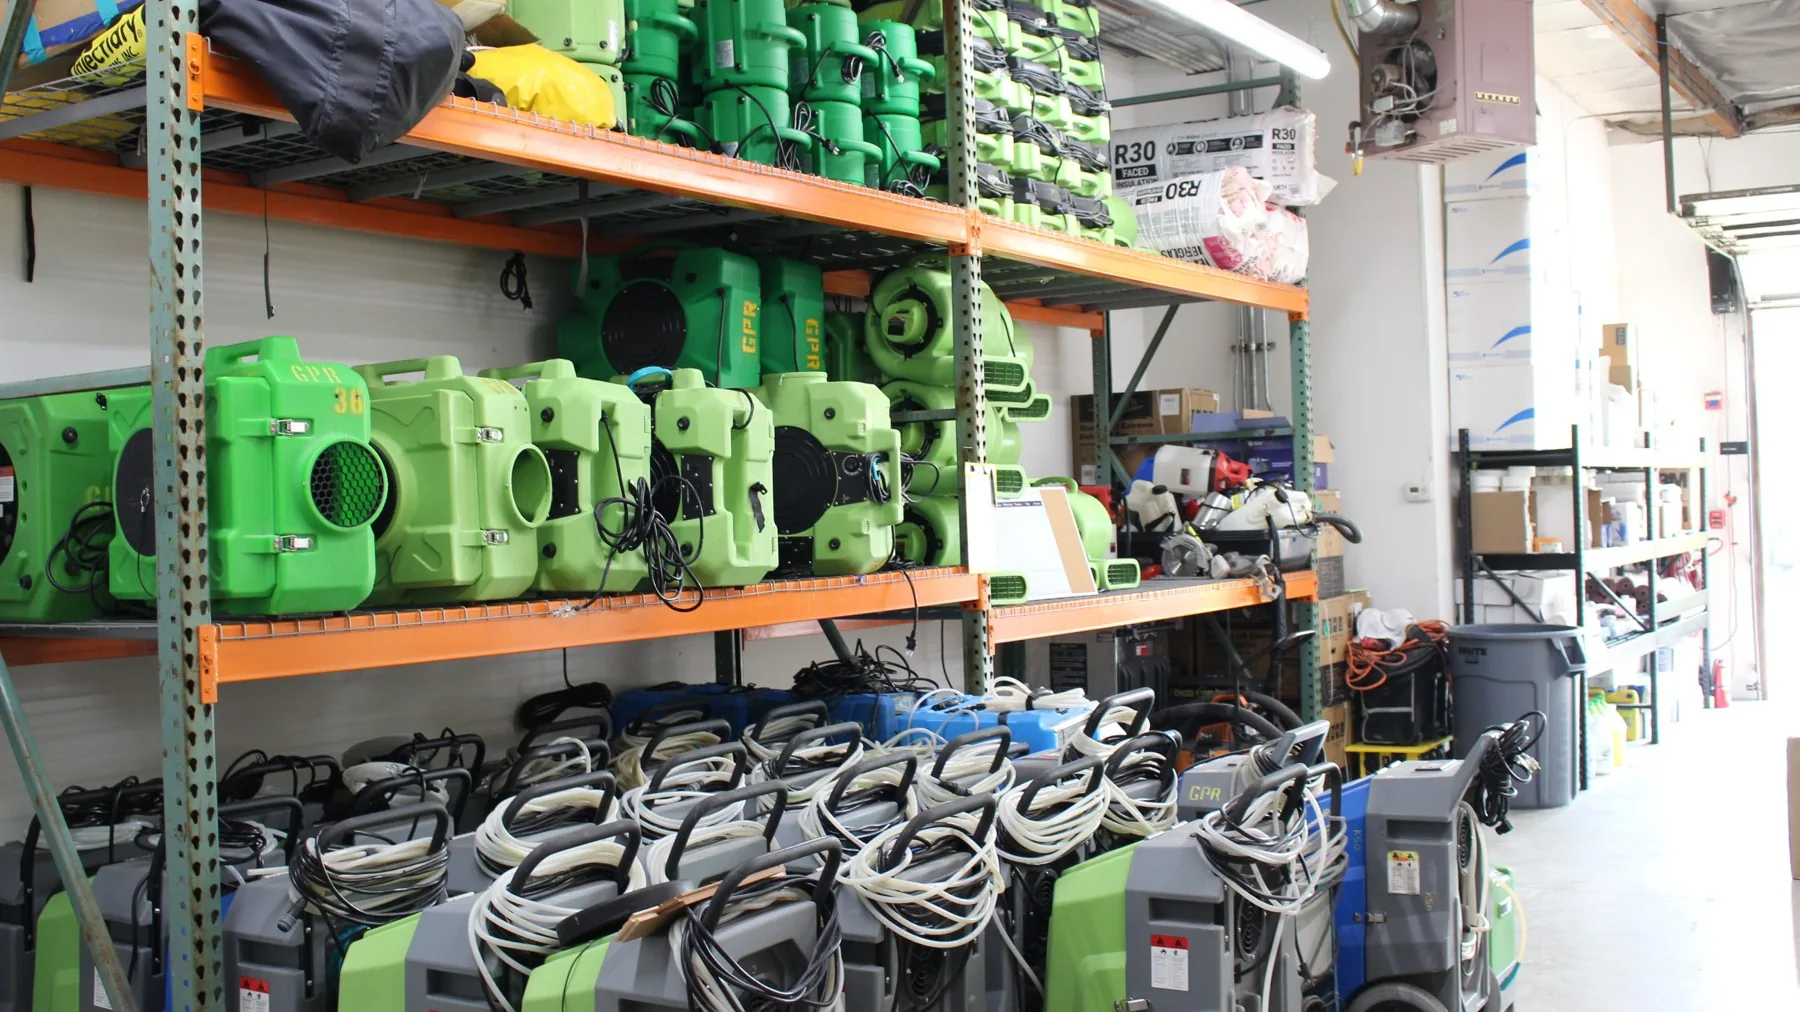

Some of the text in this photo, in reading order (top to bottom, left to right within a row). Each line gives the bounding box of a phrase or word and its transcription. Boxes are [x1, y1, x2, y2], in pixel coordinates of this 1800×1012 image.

[1272, 128, 1297, 140] R30
[1114, 140, 1156, 165] R30
[1122, 167, 1149, 178] FACED
[1116, 177, 1159, 188] INSULATION
[1165, 180, 1201, 200] R30
[742, 300, 757, 353] GPR
[806, 318, 820, 370] GPR
[290, 365, 342, 383] GPR
[1659, 471, 1688, 488] 3M
[1189, 785, 1221, 801] GPR
